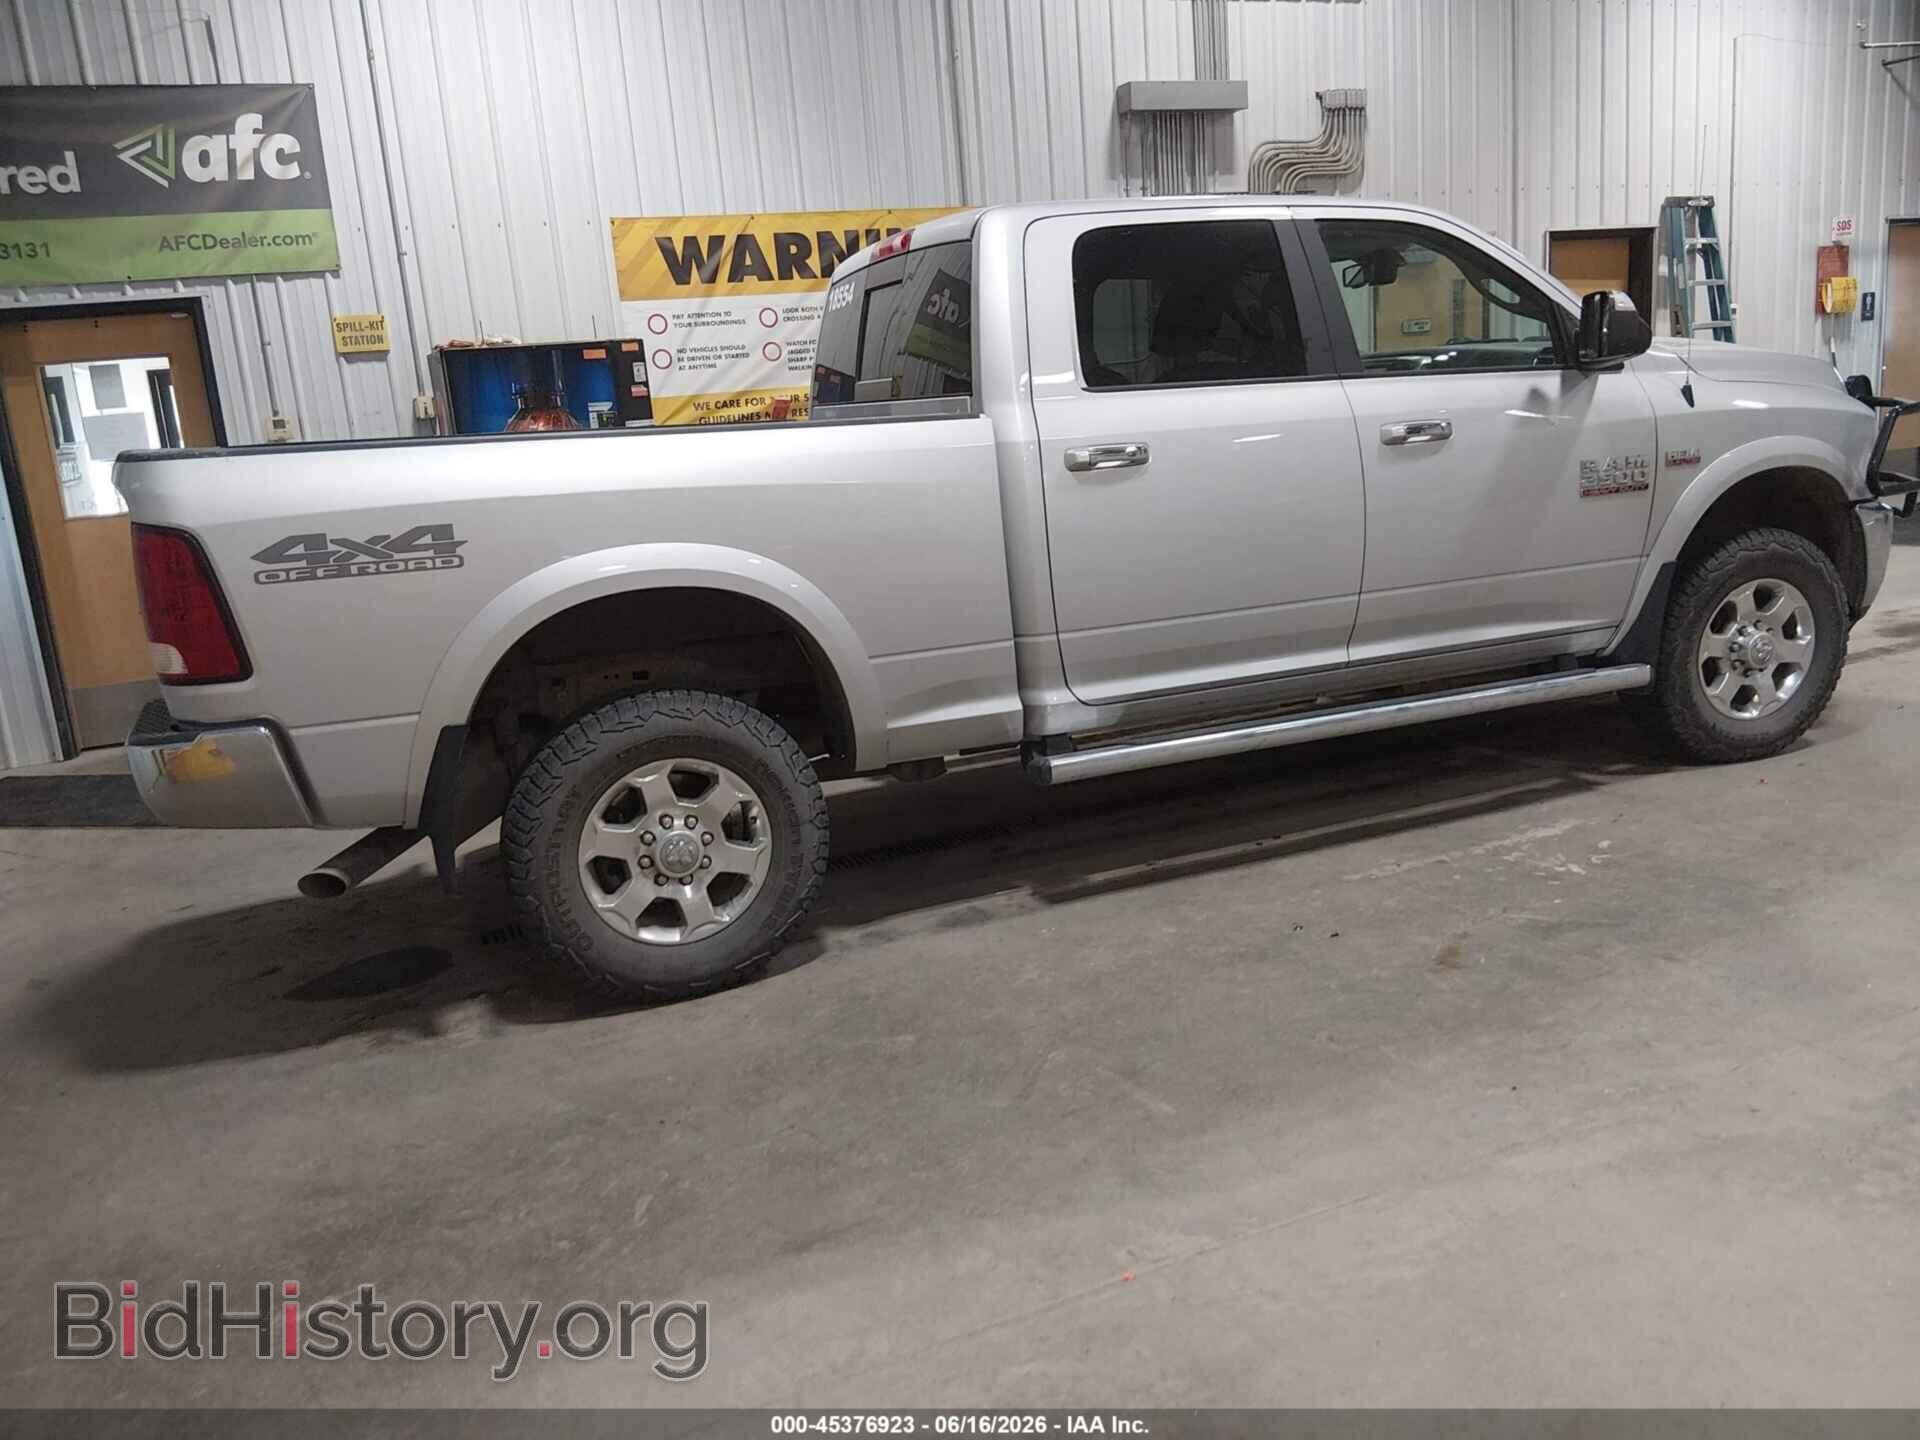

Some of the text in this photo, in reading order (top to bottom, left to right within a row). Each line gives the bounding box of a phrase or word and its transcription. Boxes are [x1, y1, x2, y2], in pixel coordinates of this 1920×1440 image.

[0, 150, 81, 194] red
[1836, 219, 1852, 231] SDS
[0, 242, 50, 260] 3131
[655, 228, 902, 285] WARN
[687, 311, 722, 319] ATTENTION
[783, 314, 816, 322] CROSSING
[335, 320, 385, 333] SPILL-KIT
[693, 319, 746, 328] SURROUNDINGS
[342, 335, 385, 347] STATION
[724, 352, 750, 360] STARTED
[688, 363, 717, 371] ANYTIME
[693, 401, 711, 411] WE
[714, 398, 742, 410] CARE
[744, 397, 766, 407] FOR
[698, 411, 762, 425] GUIDELINES
[258, 556, 460, 583] OFF ROAD
